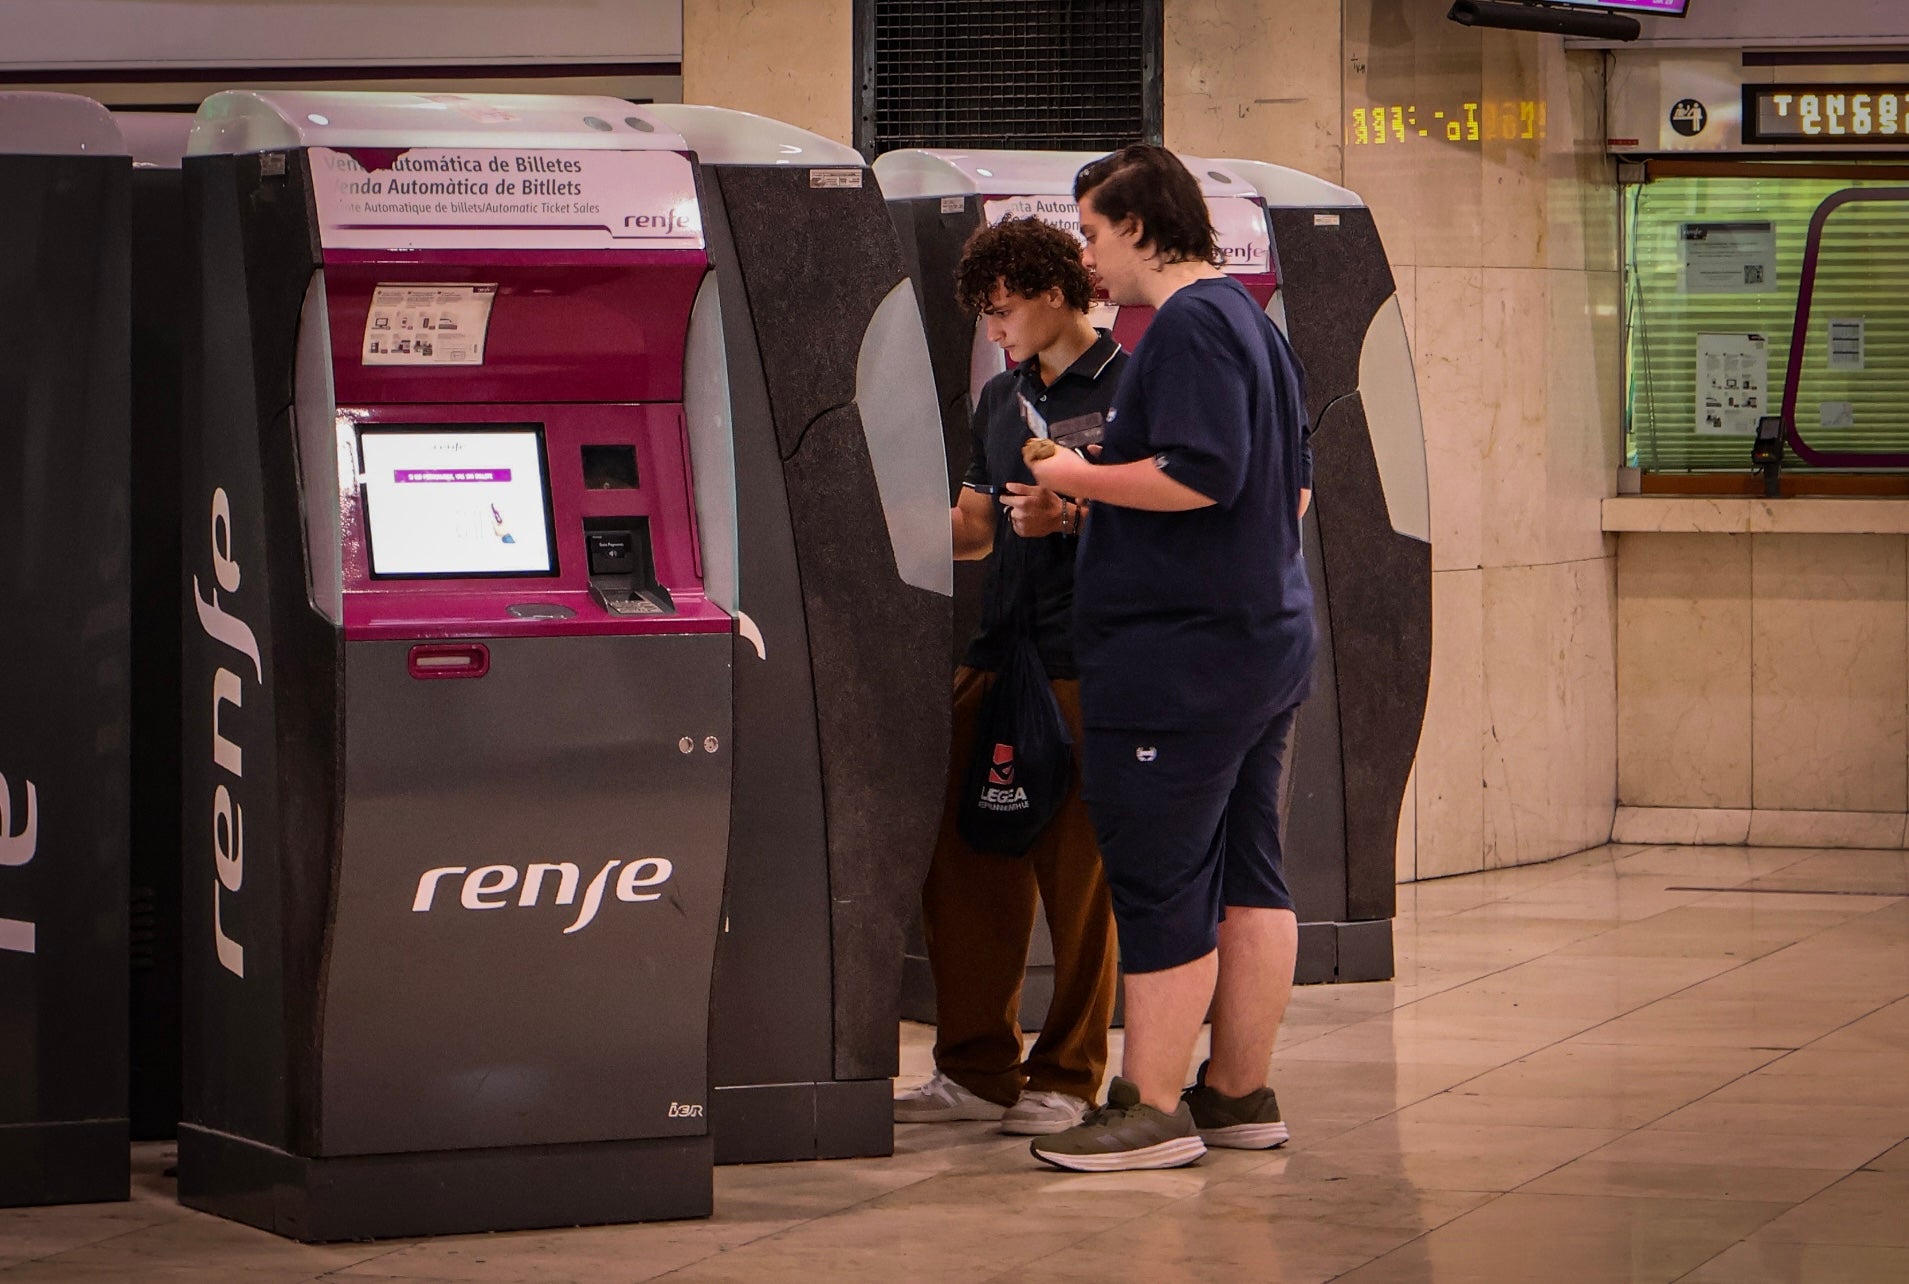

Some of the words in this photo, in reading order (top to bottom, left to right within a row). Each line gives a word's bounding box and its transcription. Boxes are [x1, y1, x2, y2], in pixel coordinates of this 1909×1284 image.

[1773, 94, 1909, 116] TANCA
[1802, 114, 1909, 135] CLOS
[390, 155, 482, 172] utomática
[489, 156, 510, 172] de
[516, 156, 582, 173] Billetes
[387, 178, 488, 195] Automàtica
[495, 178, 515, 195] de
[522, 179, 582, 195] Bitllets
[364, 202, 431, 215] Automatique
[435, 202, 448, 213] de
[451, 202, 538, 213] billets/Automatic
[541, 202, 570, 213] Ticket
[573, 203, 600, 214] Sales
[623, 208, 690, 235] renfe
[194, 488, 262, 979] renfe
[411, 856, 673, 934] renfe
